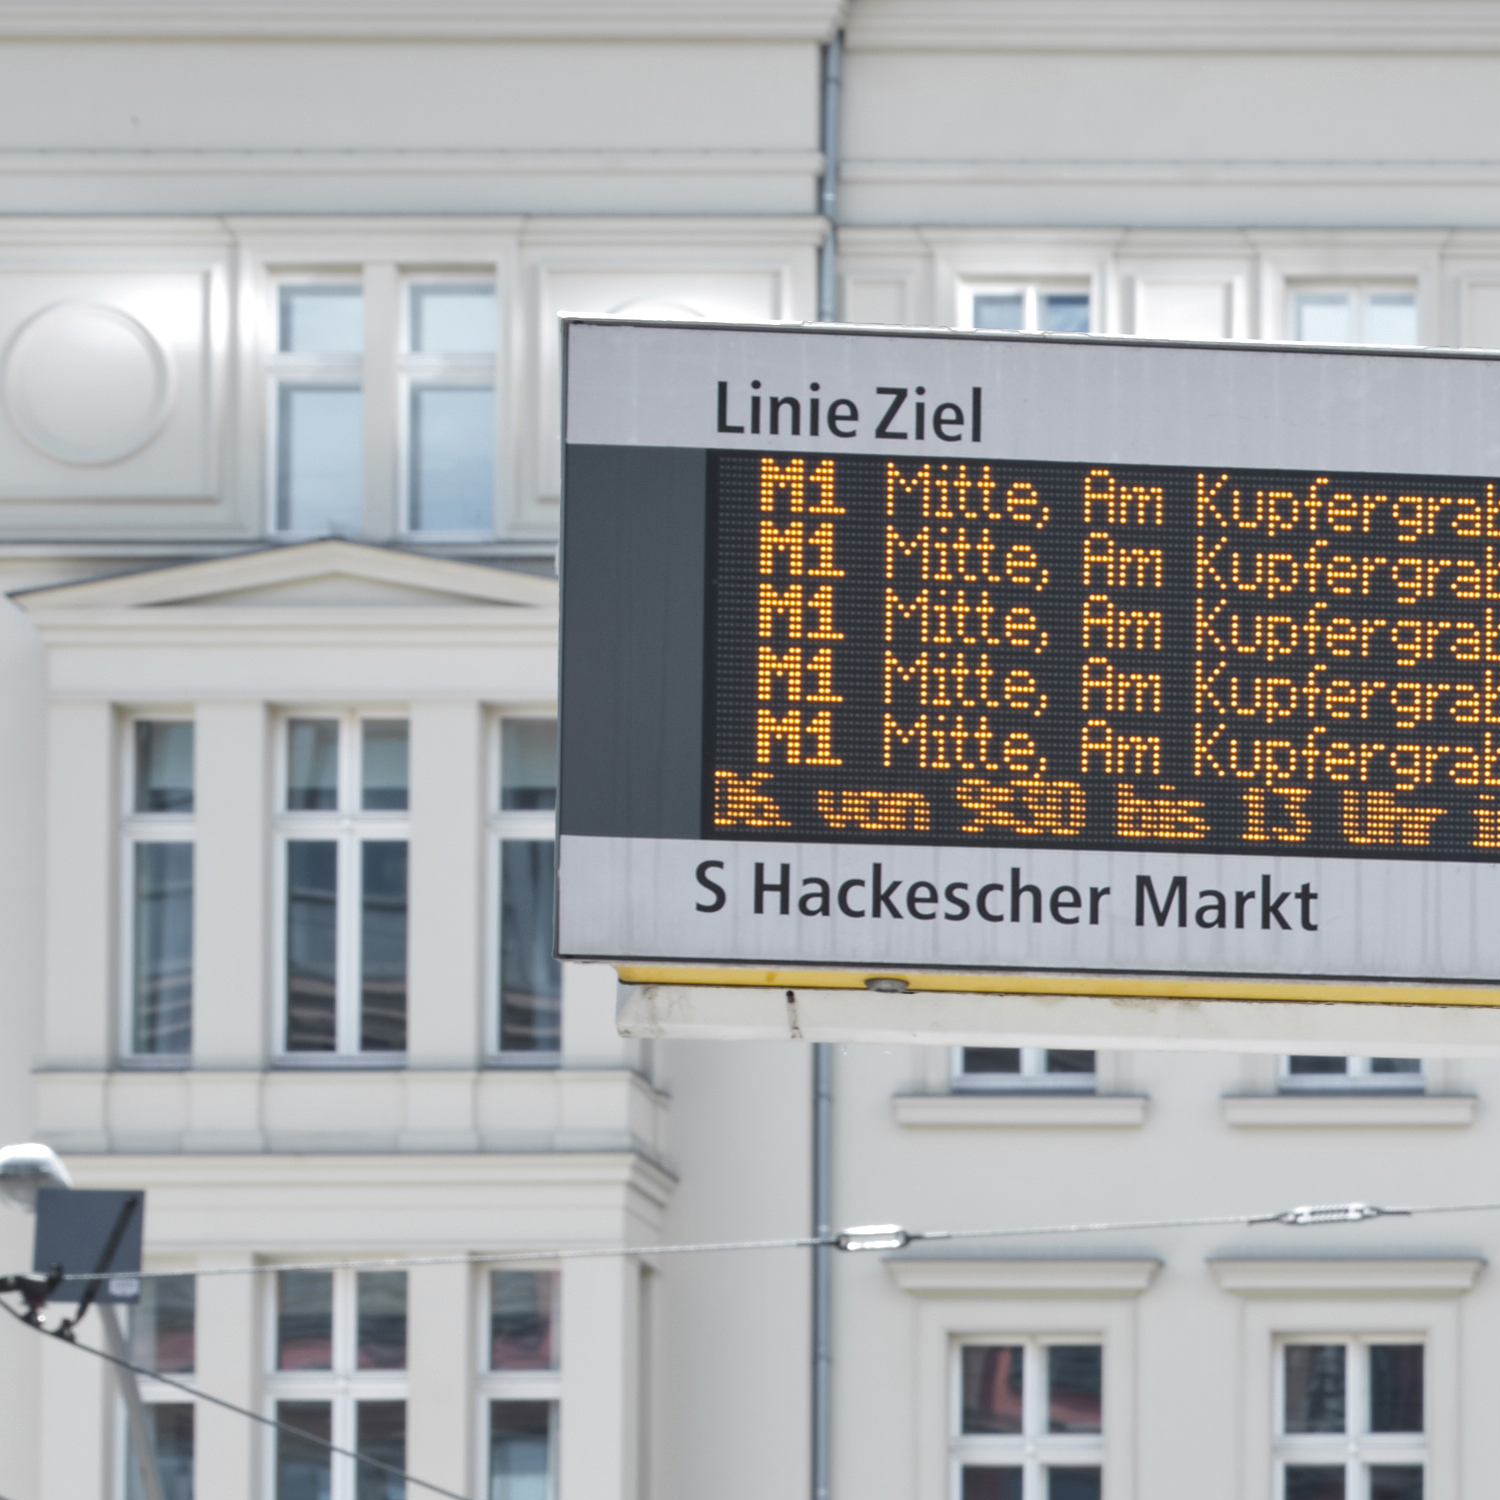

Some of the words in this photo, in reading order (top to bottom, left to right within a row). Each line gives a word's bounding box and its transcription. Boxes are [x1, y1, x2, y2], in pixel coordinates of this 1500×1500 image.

[718, 380, 858, 438] Linie
[875, 386, 981, 442] Ziel
[760, 458, 846, 514] M1
[886, 462, 1049, 531] Mitte,
[1084, 469, 1163, 525] Am
[759, 520, 845, 577] M1
[885, 522, 1049, 594] Mitte,
[1083, 532, 1163, 587] Am
[758, 583, 844, 640] M1
[884, 585, 1048, 657] Mitte,
[1082, 594, 1162, 650] Am
[757, 646, 843, 702] M1
[884, 647, 1047, 719] Mitte,
[1082, 657, 1161, 712] Am
[757, 709, 843, 765] M1
[884, 710, 1047, 779] Mitte,
[1081, 719, 1160, 775] Am
[818, 790, 930, 830] von
[1117, 783, 1211, 838] bis
[1343, 790, 1447, 845] Uhr
[696, 860, 726, 912] S
[754, 863, 1110, 924] Hackescher
[1136, 875, 1318, 931] Markt
